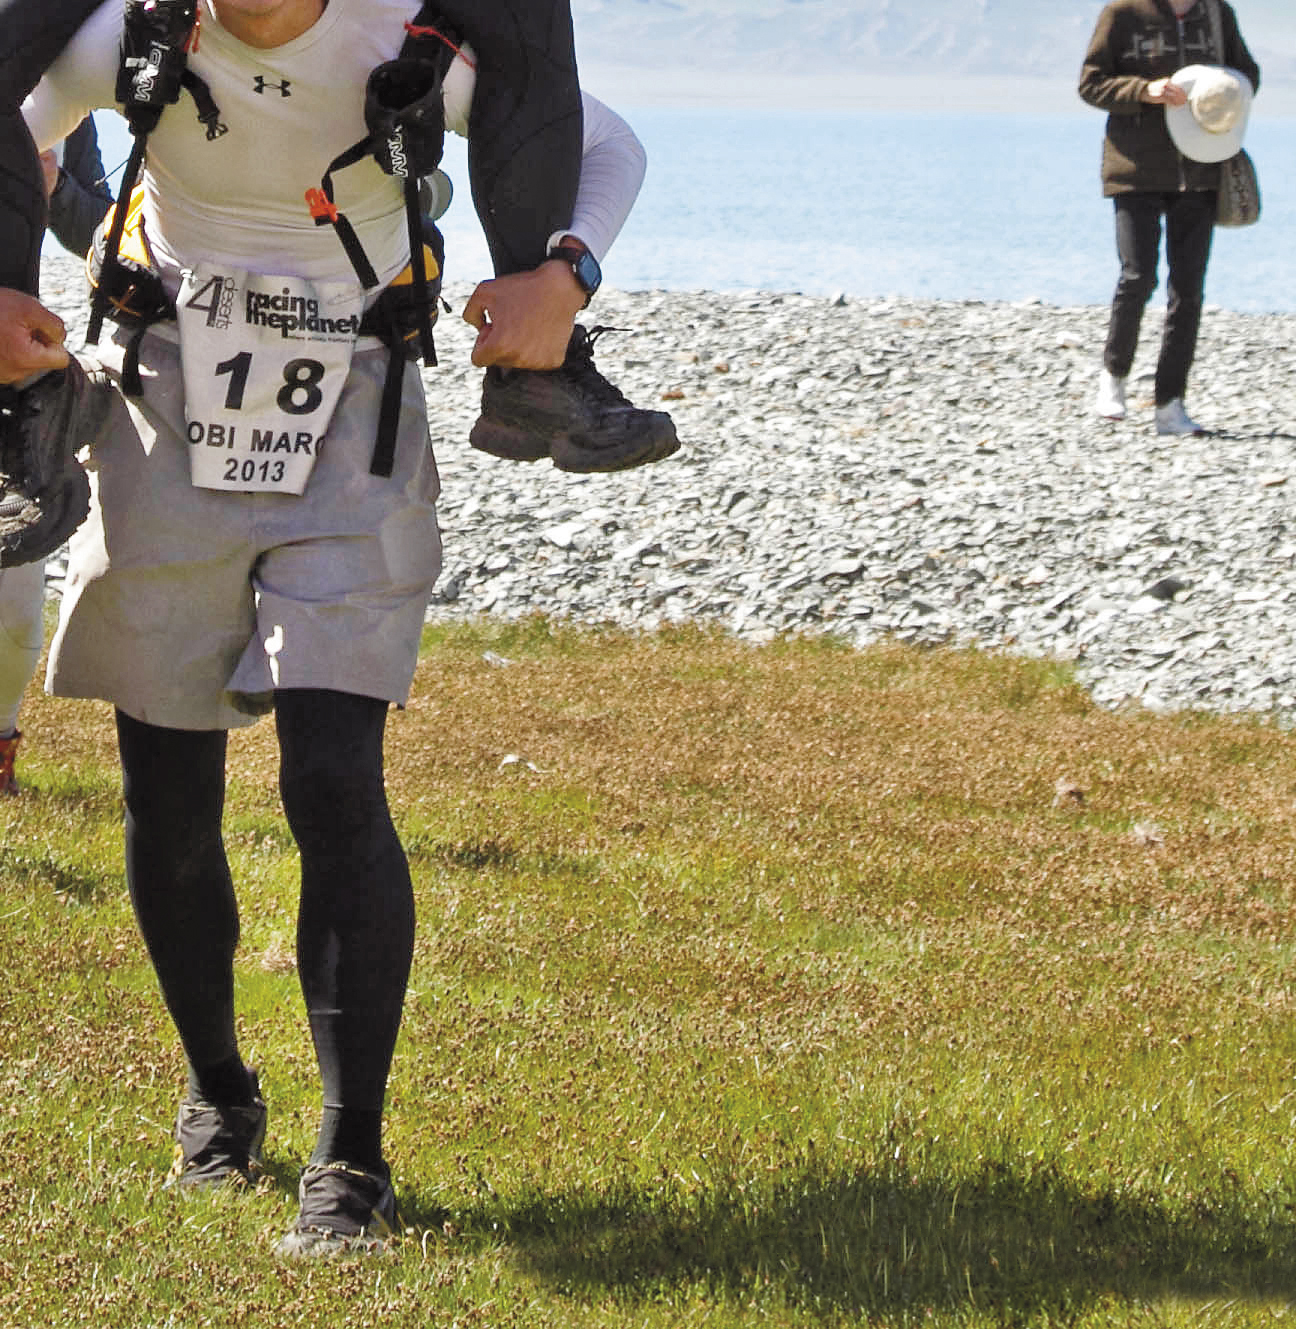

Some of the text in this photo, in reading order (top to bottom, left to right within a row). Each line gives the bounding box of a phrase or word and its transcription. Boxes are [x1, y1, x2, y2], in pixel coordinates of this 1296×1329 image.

[185, 275, 224, 328] 4
[246, 287, 319, 318] racing
[214, 351, 326, 415] 18
[187, 420, 235, 450] OBI
[223, 458, 286, 482] 2013
